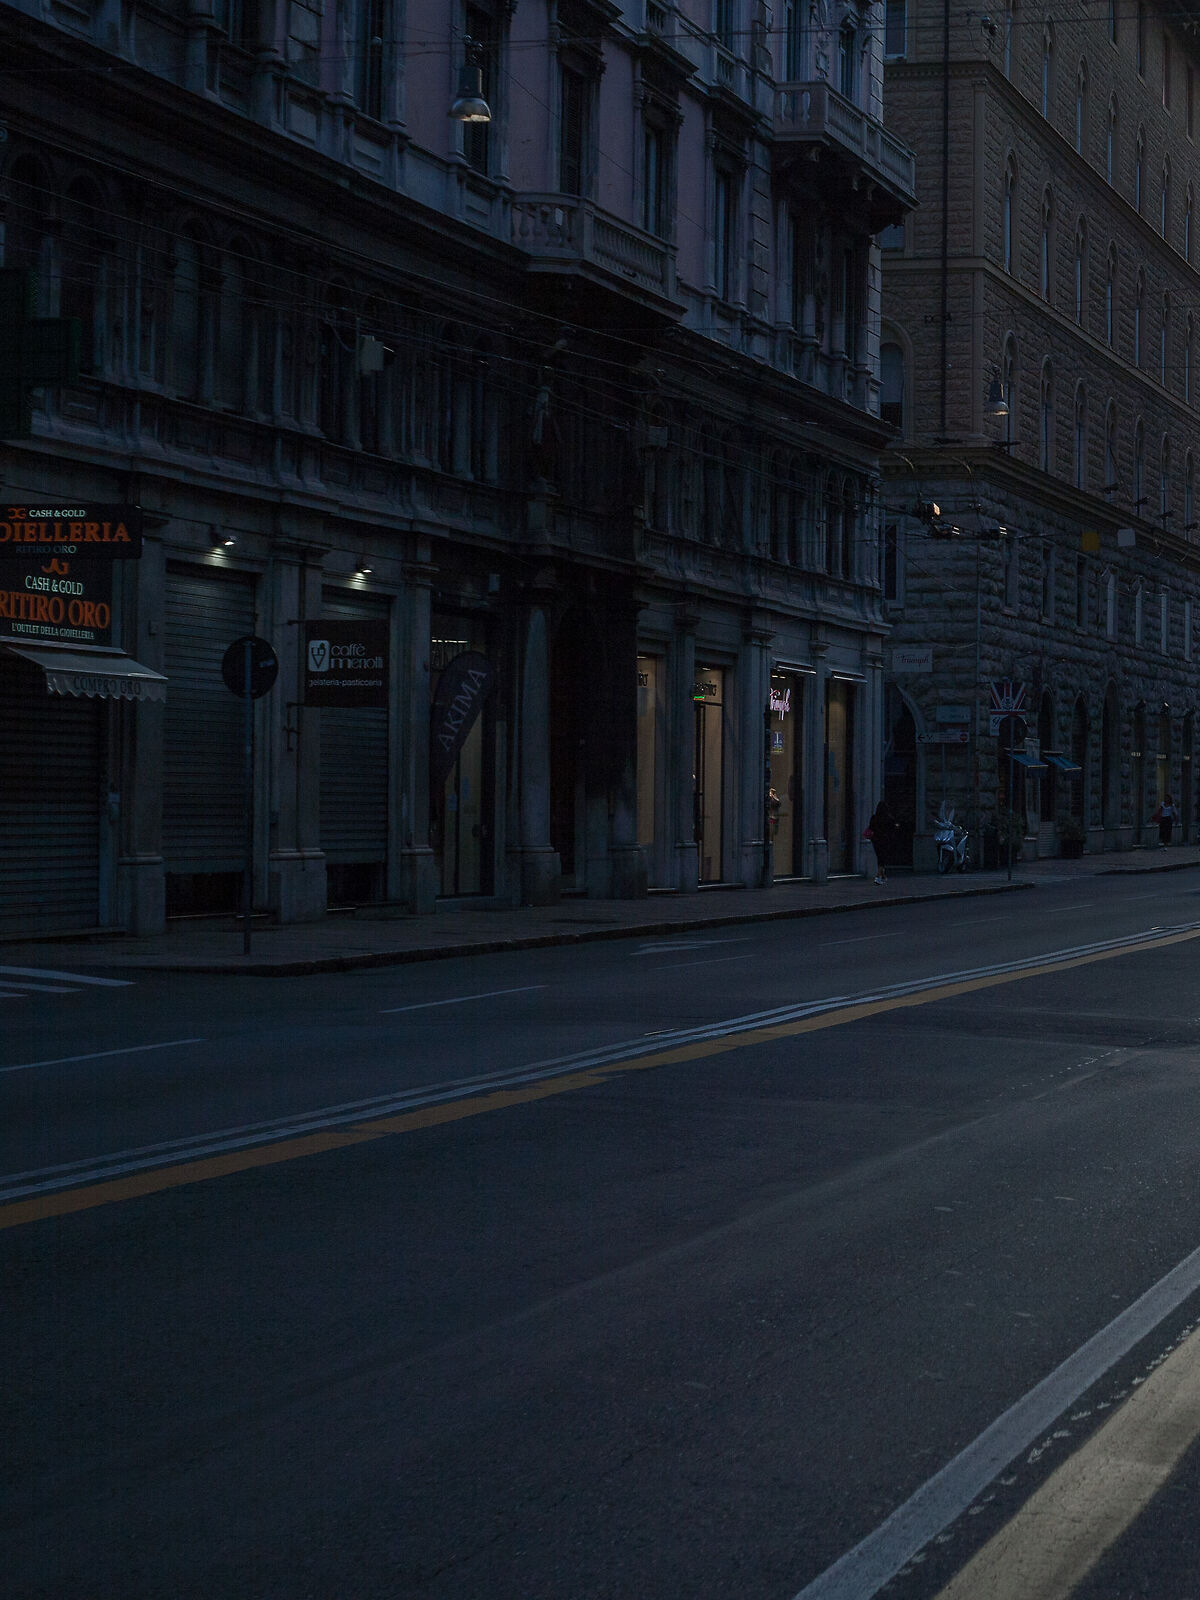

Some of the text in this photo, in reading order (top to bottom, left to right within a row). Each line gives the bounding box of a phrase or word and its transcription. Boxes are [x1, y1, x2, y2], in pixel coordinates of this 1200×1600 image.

[53, 544, 77, 554] ORO
[67, 599, 110, 629] ORO
[40, 625, 60, 636] DELLA
[438, 669, 488, 752] AKIMA
